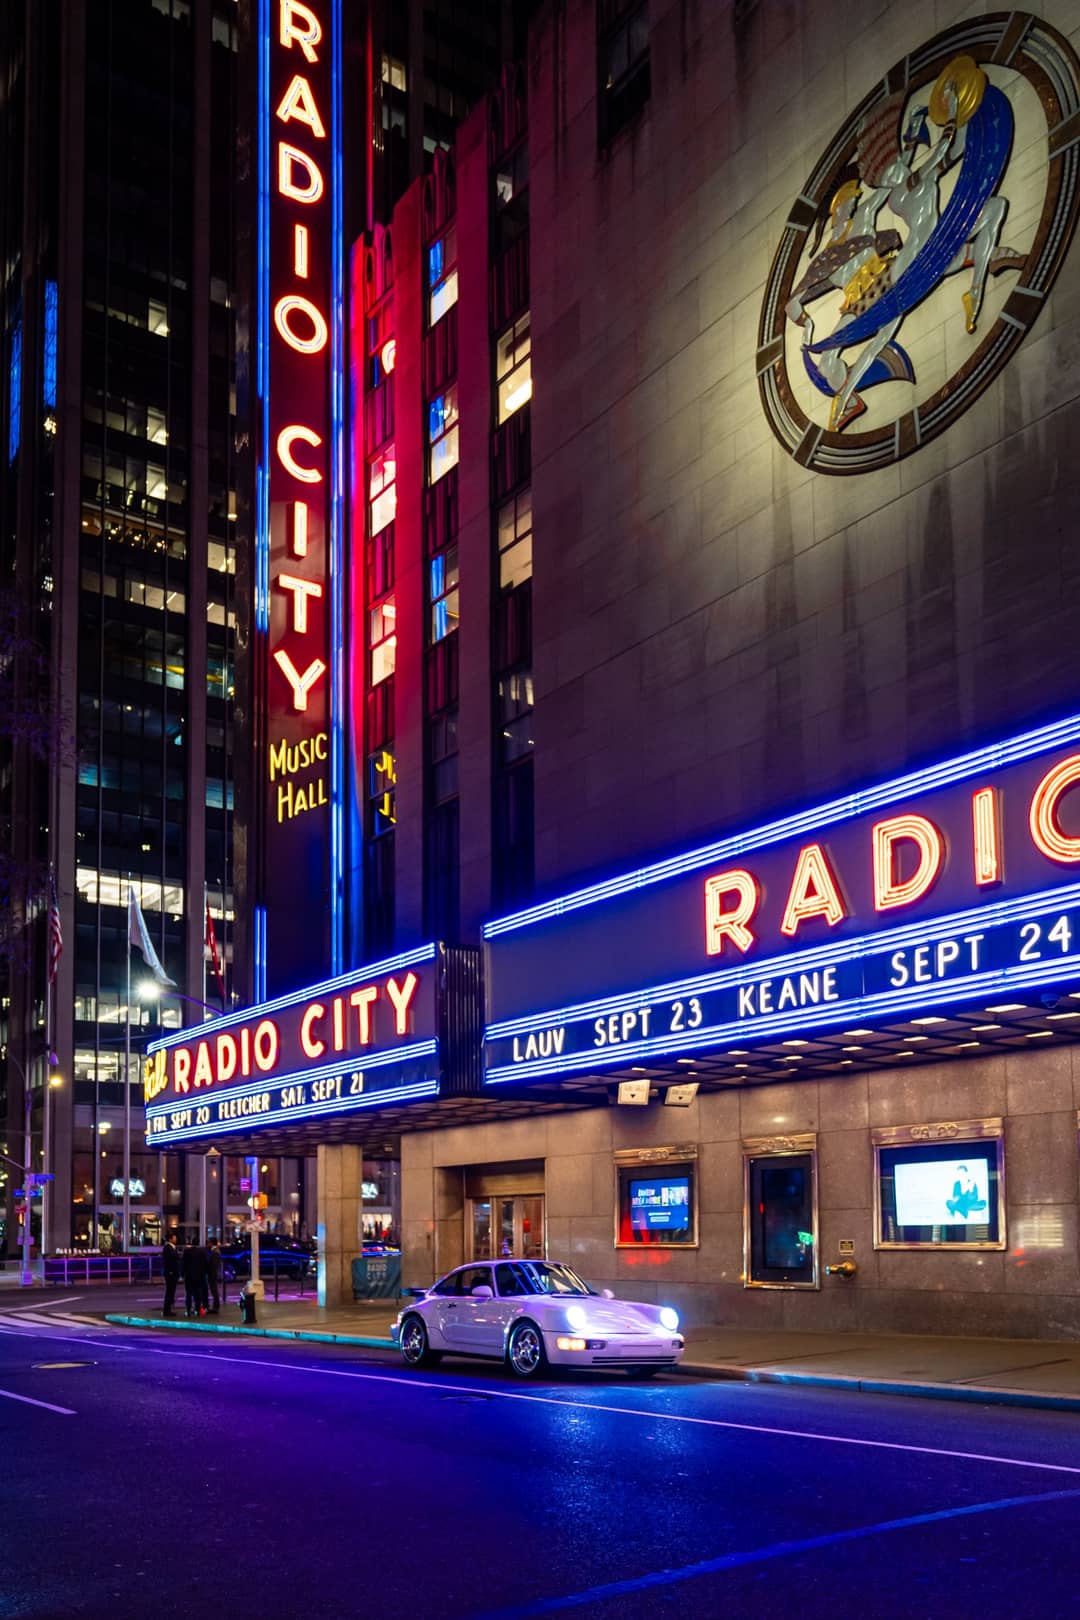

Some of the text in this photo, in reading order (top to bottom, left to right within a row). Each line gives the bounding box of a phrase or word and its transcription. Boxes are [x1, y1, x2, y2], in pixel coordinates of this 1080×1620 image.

[273, 0, 328, 712] RADIO CITY
[269, 733, 327, 781] MUSIC
[278, 778, 327, 823] HALL
[174, 1020, 277, 1093] RADIO
[301, 972, 417, 1058] CITY
[513, 915, 1072, 1062] LAUV SEPT 23 KEANE SEPT 24
[171, 1109, 192, 1130] SEPT
[196, 1106, 210, 1125] 20
[219, 1092, 270, 1120] FLETCHER
[311, 1076, 343, 1100] SEPT
[350, 1071, 364, 1094] 21
